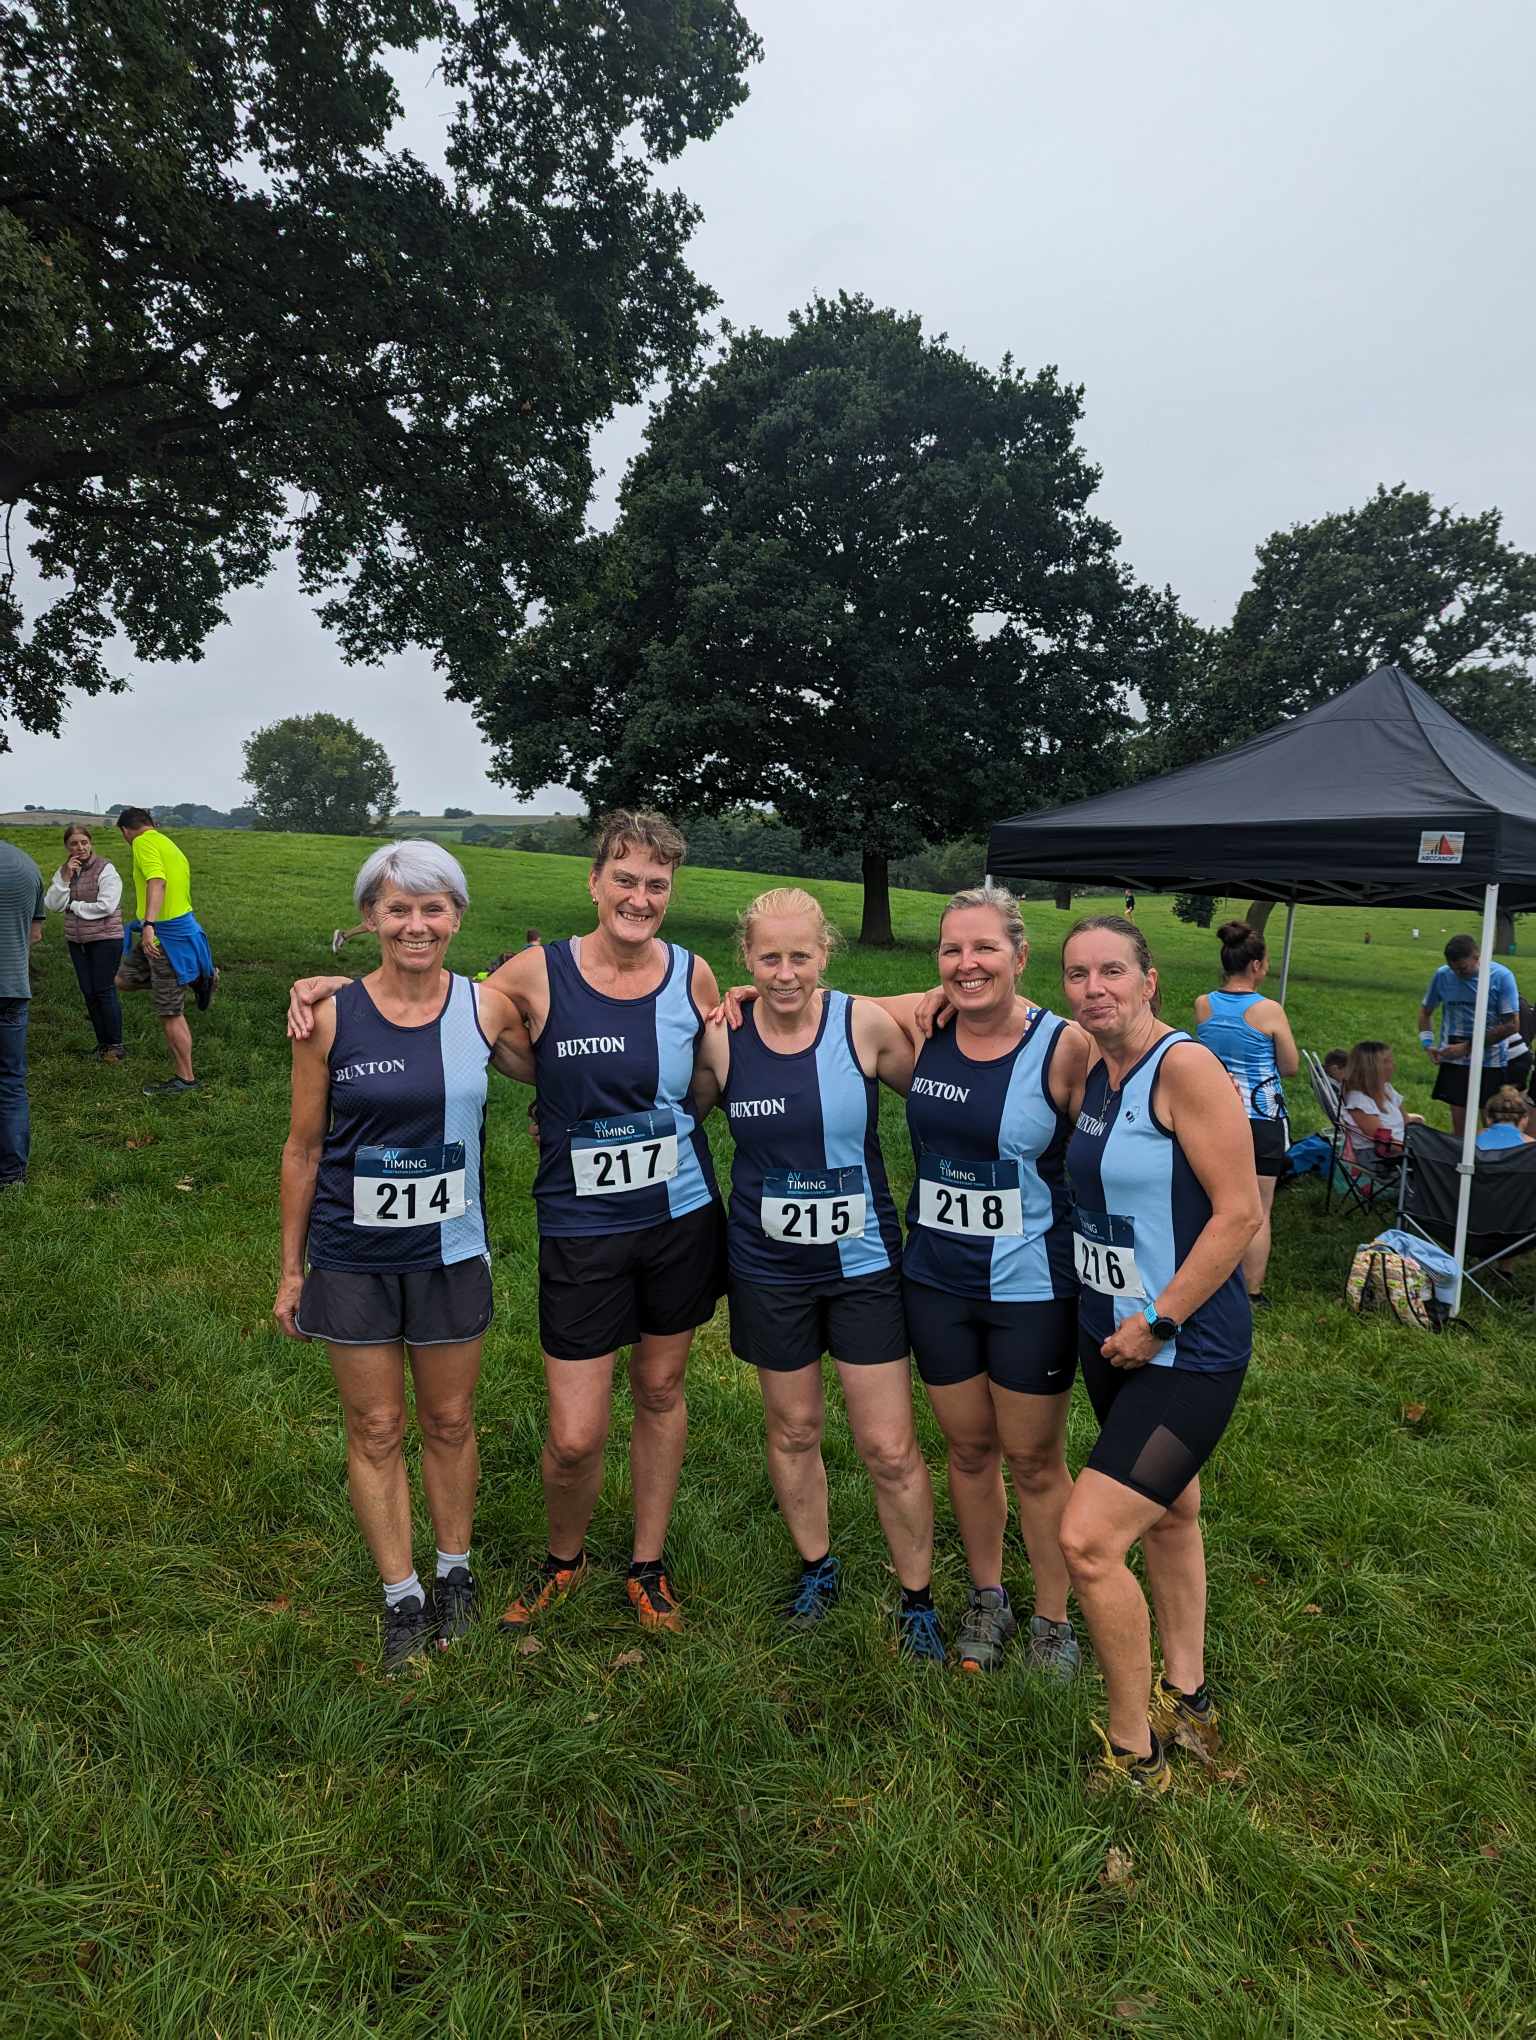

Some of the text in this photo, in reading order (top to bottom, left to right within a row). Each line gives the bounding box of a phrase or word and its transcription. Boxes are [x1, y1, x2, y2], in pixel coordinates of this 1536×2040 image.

[557, 1036, 625, 1058] BUXTON
[335, 1059, 405, 1082] BUXTON
[911, 1076, 971, 1104] BUXTON
[730, 1097, 786, 1119] BUXTON
[593, 1120, 608, 1132] AV
[596, 1124, 636, 1138] TIMING
[382, 1150, 400, 1161] AV
[384, 1159, 428, 1169] TIMING
[593, 1143, 662, 1187] 217
[939, 1159, 952, 1168] AV
[787, 1171, 801, 1181] AV
[788, 1180, 827, 1190] TIMING
[939, 1166, 976, 1182] TIMING
[376, 1178, 450, 1220] 214
[936, 1189, 1004, 1230] 218
[781, 1200, 850, 1238] 215
[1082, 1242, 1126, 1290] 216
